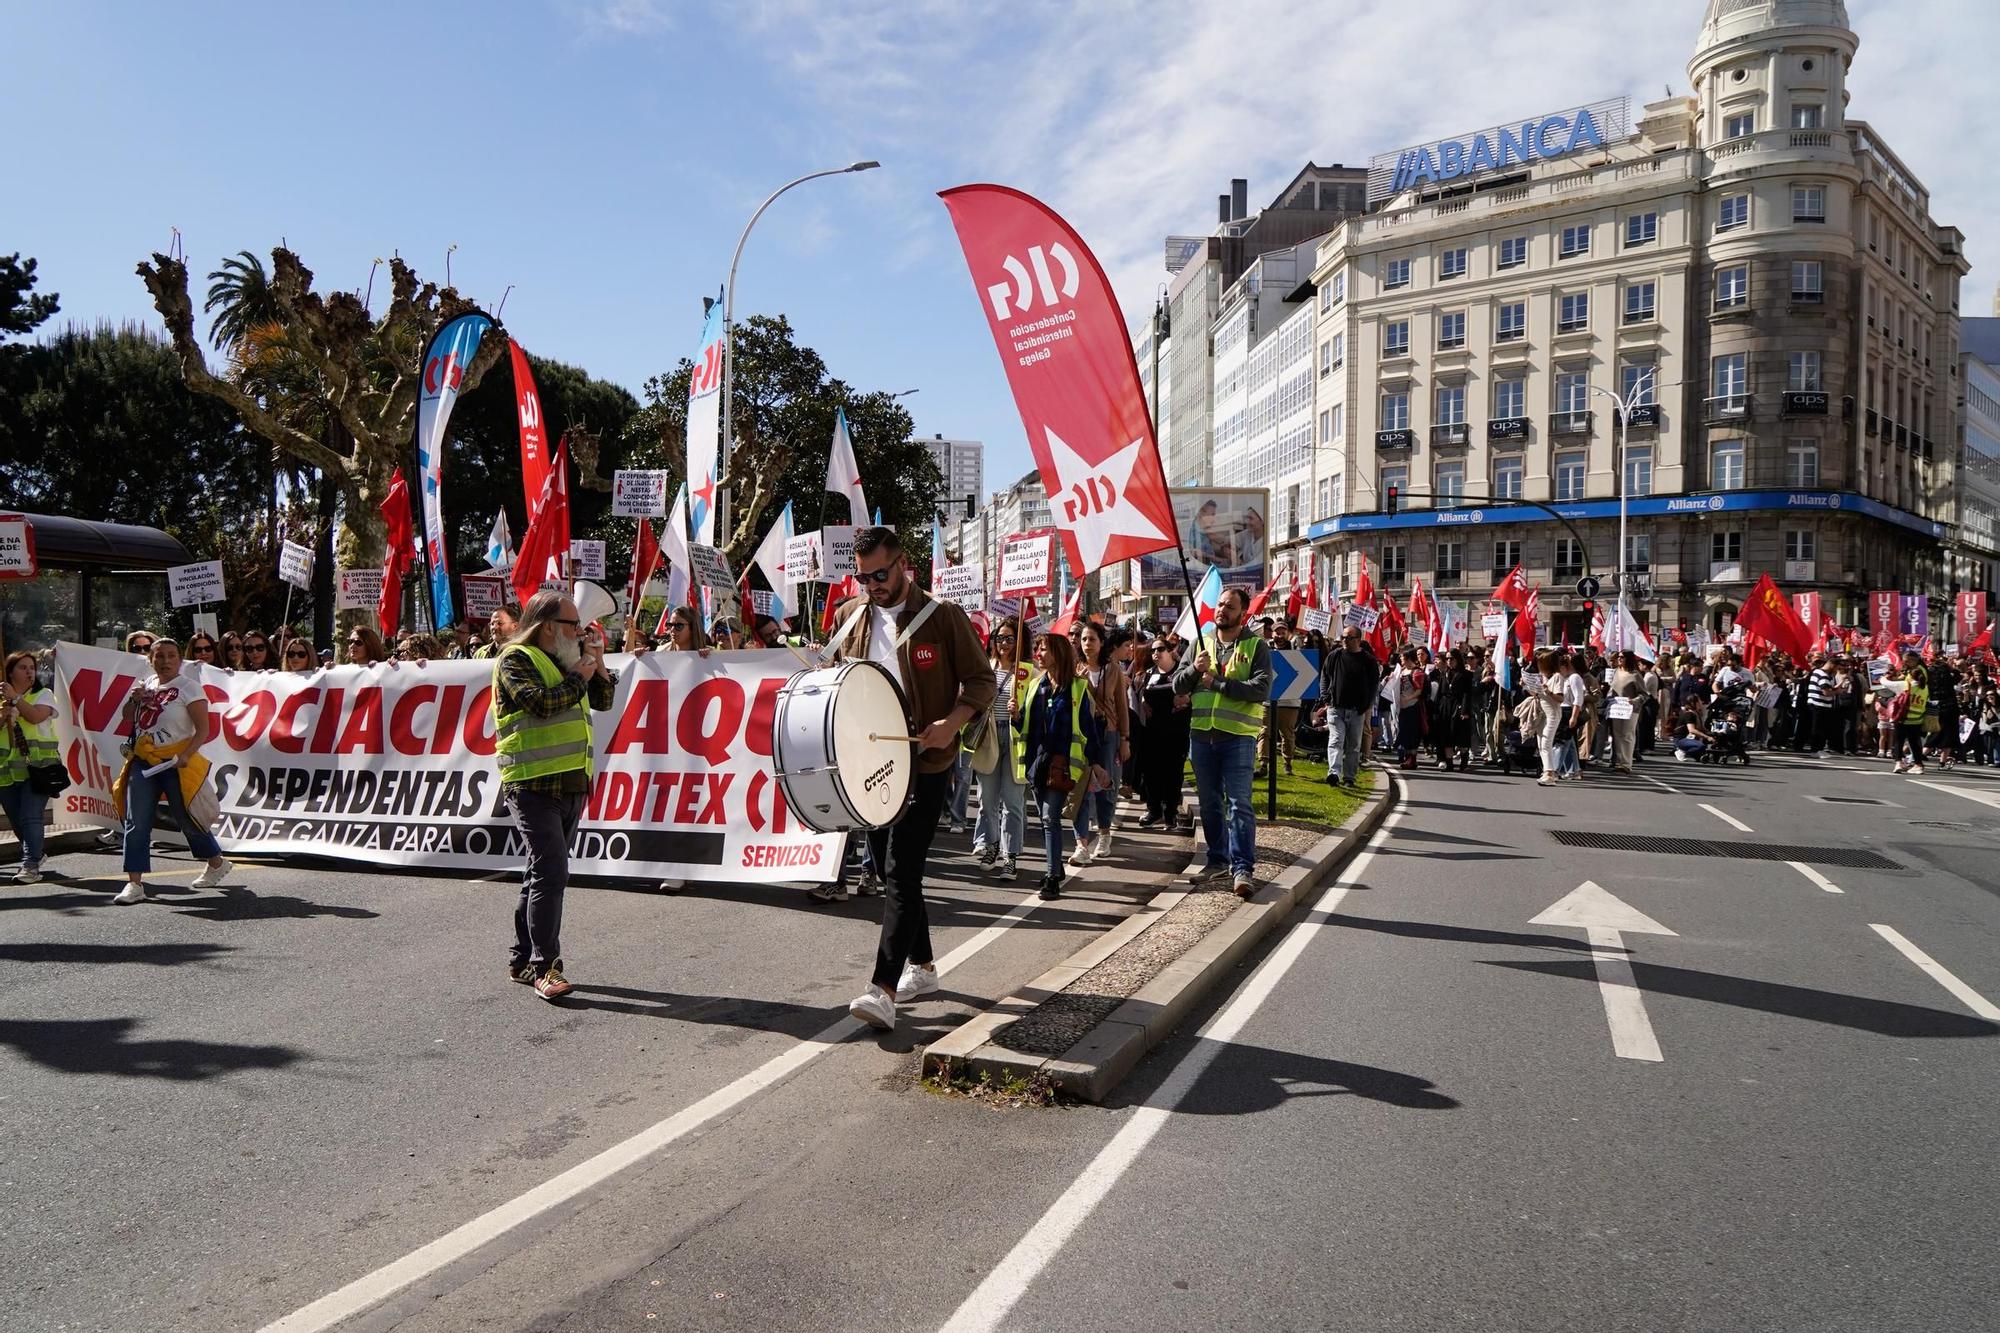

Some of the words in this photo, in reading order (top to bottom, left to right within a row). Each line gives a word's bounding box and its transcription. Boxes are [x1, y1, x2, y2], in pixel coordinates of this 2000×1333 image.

[1403, 108, 1602, 186] ABANCA
[1631, 408, 1650, 419] ps
[1492, 421, 1520, 431] aps
[1380, 432, 1405, 442] aps
[1667, 497, 1706, 511] Allianz
[1788, 494, 1827, 506] Allianz
[1437, 512, 1469, 523] Allianz
[0, 557, 21, 565] CIÓN
[790, 551, 807, 560] COMIDA
[1005, 550, 1047, 562] TRABALLAMOS
[179, 573, 215, 582] VINCULACIÓN
[787, 570, 796, 578] TRA
[944, 576, 971, 584] RESPECTA
[938, 588, 982, 599] PRESENTACIÓN
[1879, 593, 1890, 631] UGT
[1907, 597, 1919, 634] UGT
[1965, 594, 1977, 632] UGT
[235, 766, 489, 818] DEPENDENTAS
[579, 771, 735, 825] NDITEX
[390, 826, 454, 853] PARA
[466, 828, 491, 856] O
[742, 844, 823, 867] SERVIZOS
